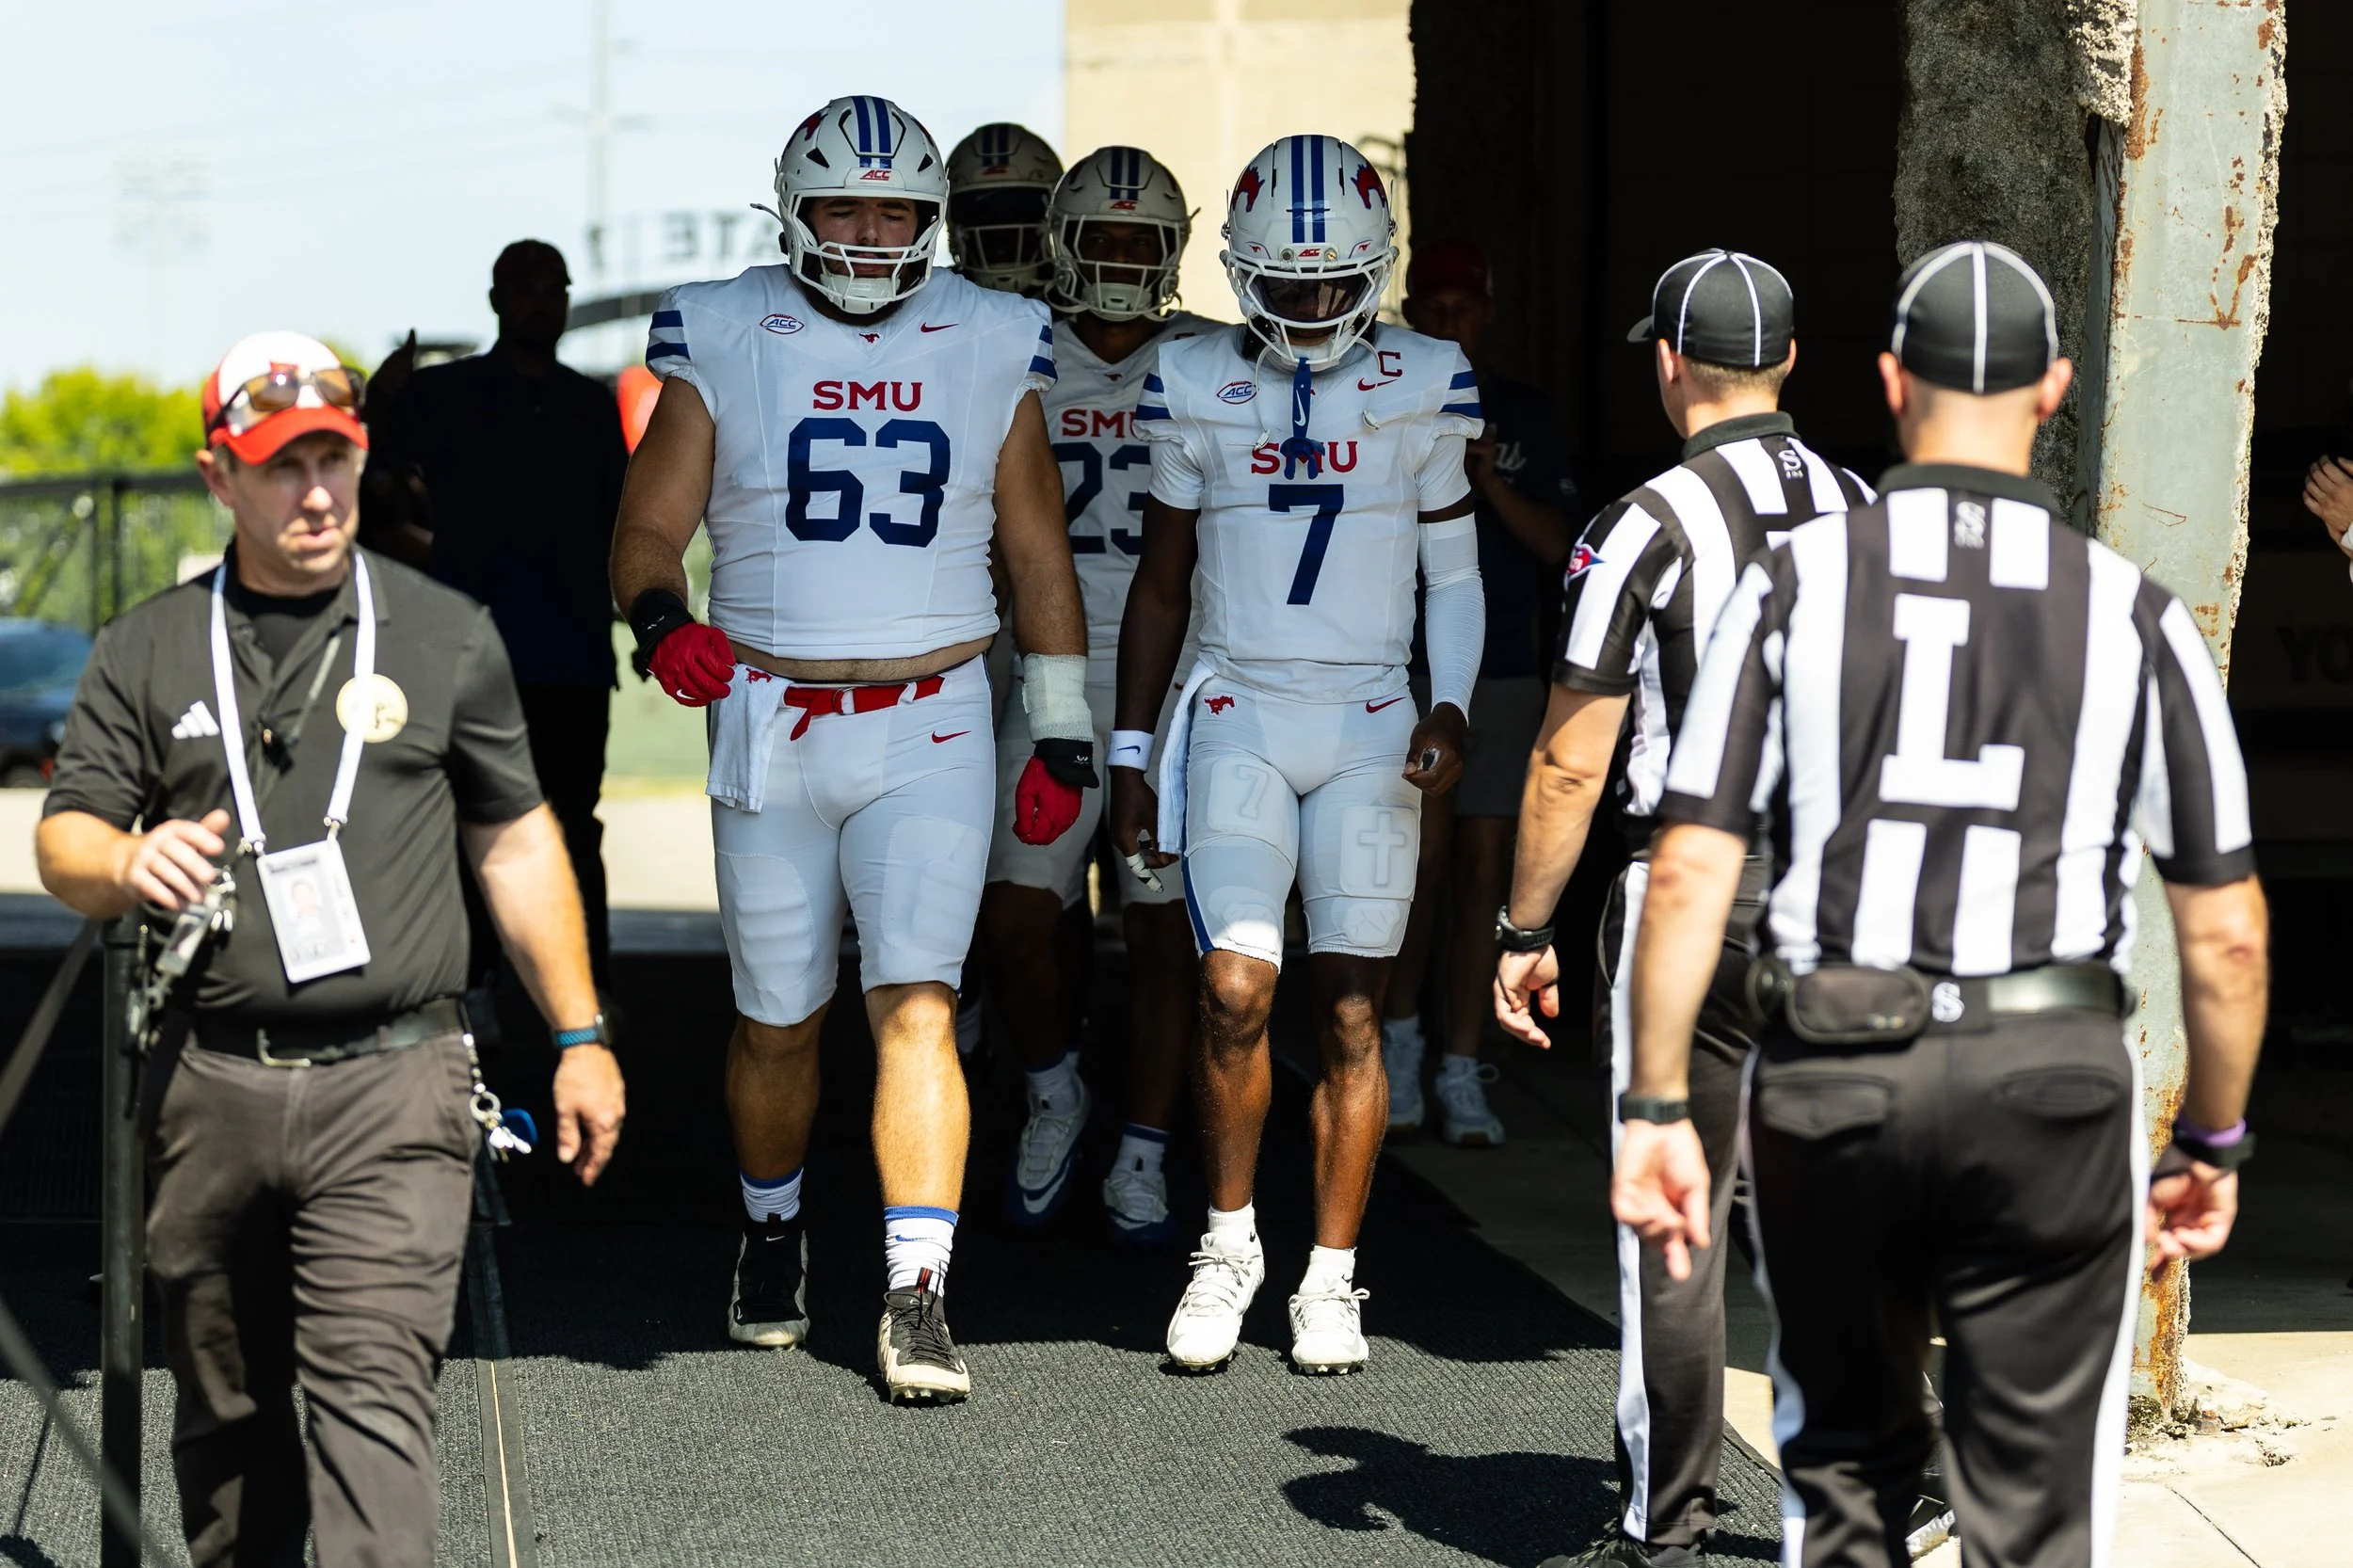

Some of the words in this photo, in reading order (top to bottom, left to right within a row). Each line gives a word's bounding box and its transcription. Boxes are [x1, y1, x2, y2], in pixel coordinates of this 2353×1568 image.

[858, 169, 891, 181] ACC
[1298, 248, 1321, 257] ACC
[764, 318, 798, 329] ACC
[1377, 350, 1403, 377] C
[812, 380, 922, 412] SMU
[1221, 384, 1253, 398] ACC
[785, 417, 952, 548] 63
[1051, 441, 1152, 555] 23
[1268, 483, 1345, 606] 7
[1879, 592, 2025, 812] L
